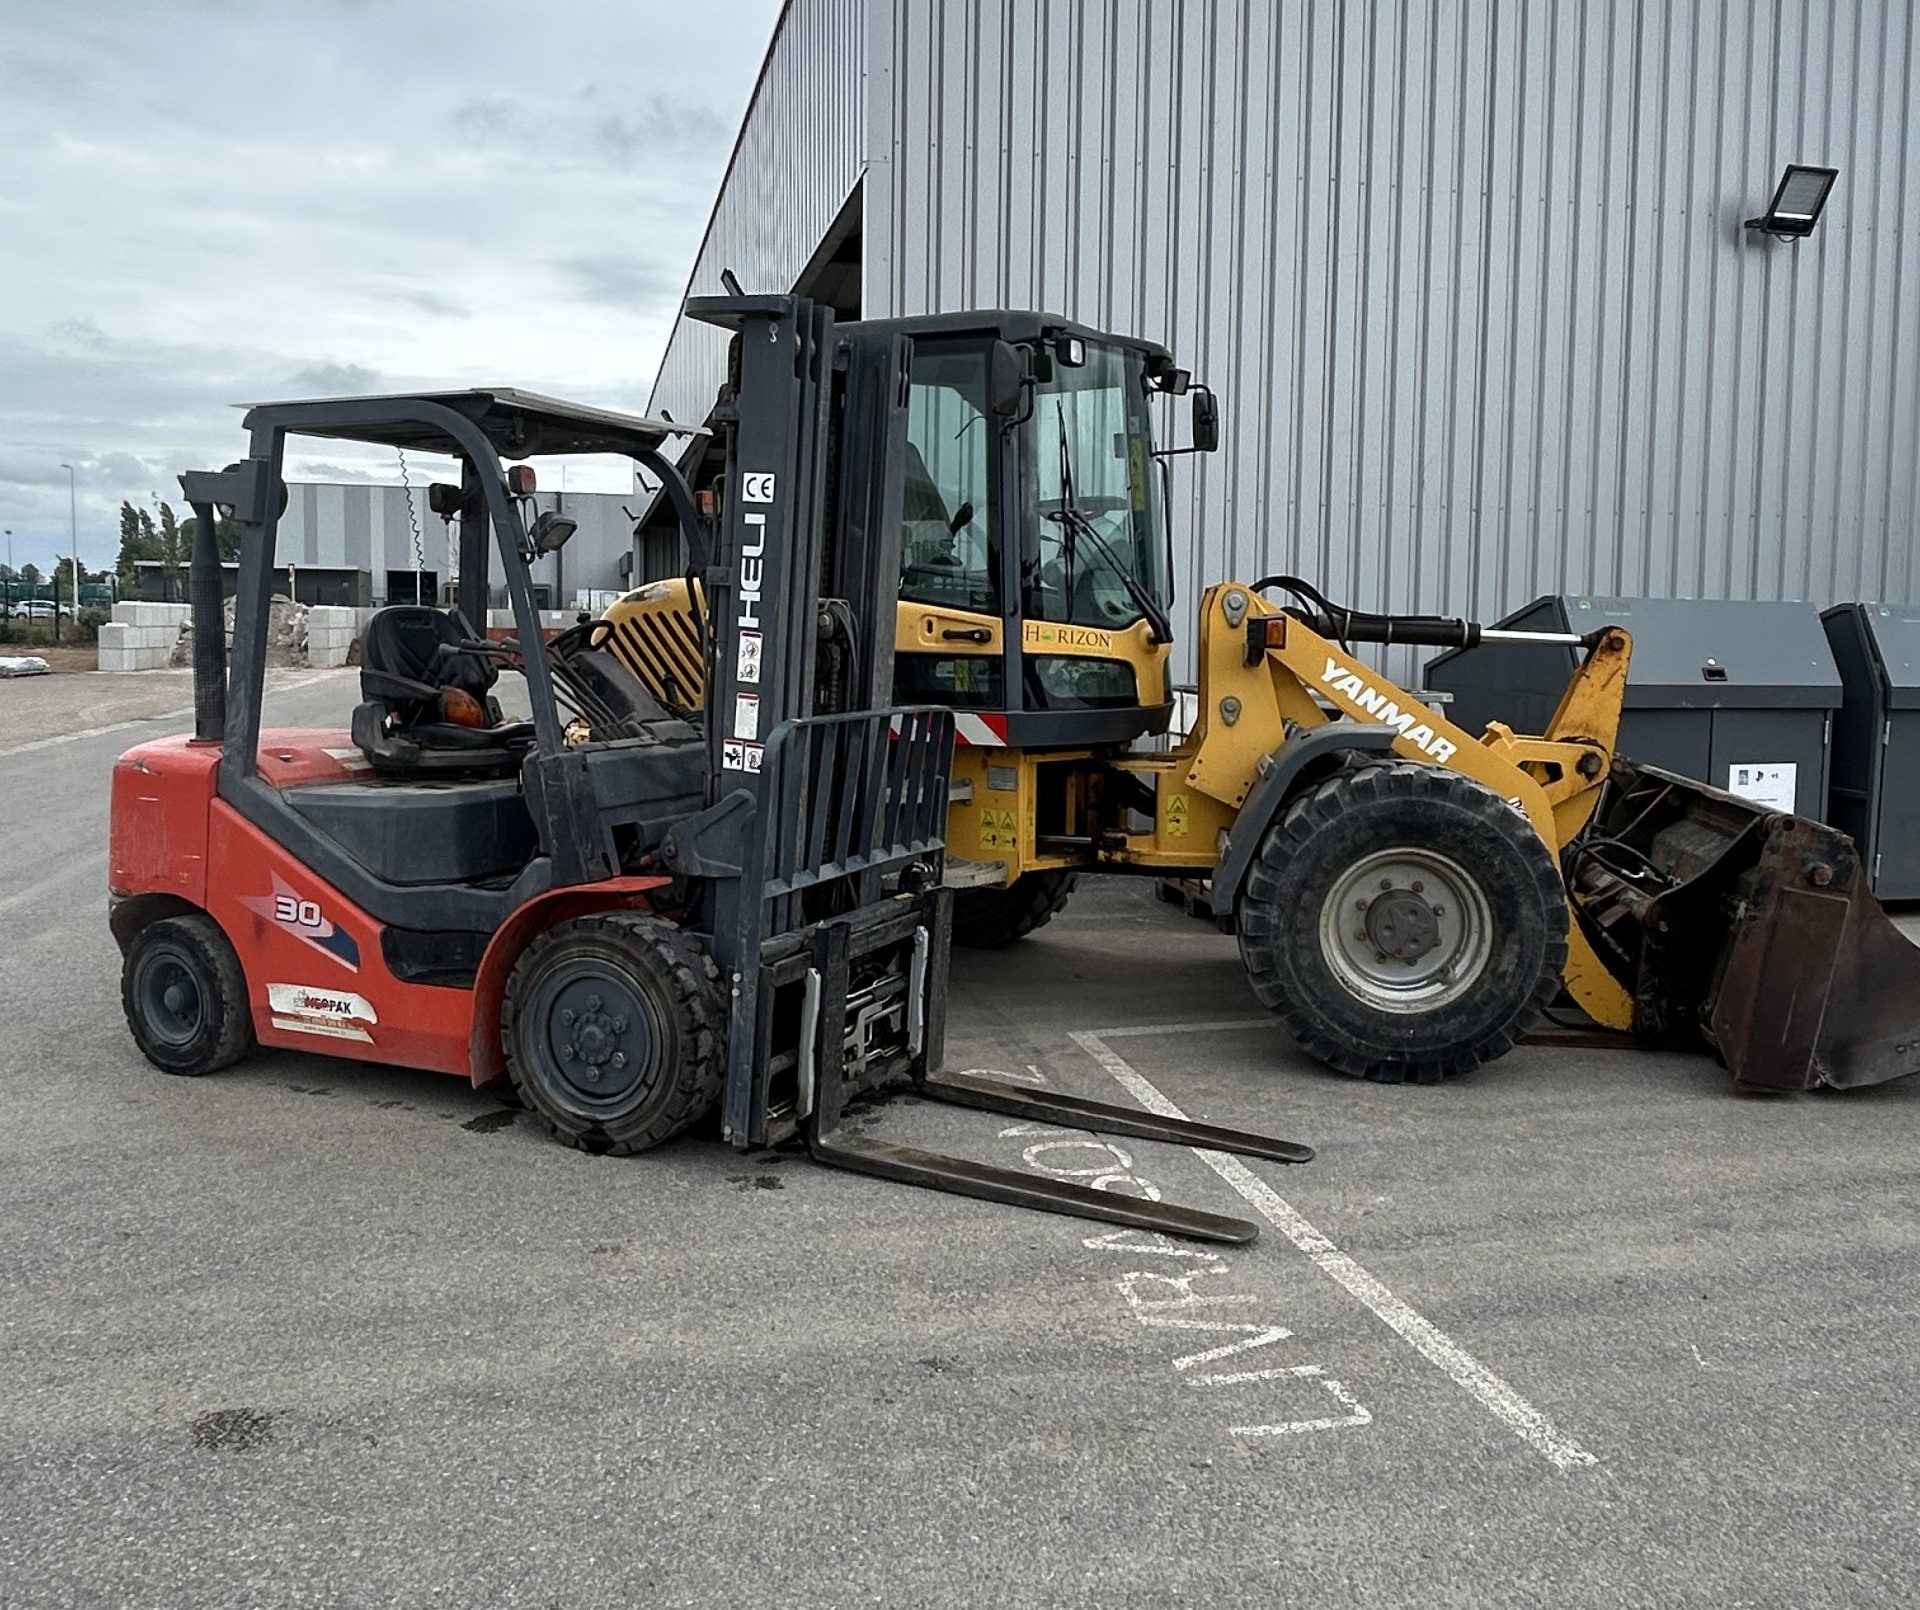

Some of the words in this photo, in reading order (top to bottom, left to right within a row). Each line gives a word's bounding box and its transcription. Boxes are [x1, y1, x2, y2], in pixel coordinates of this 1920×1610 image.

[746, 476, 772, 499] CE
[737, 513, 766, 629] HELI
[1025, 624, 1111, 648] HRIZON
[1320, 657, 1458, 764] YANMAR
[275, 895, 322, 927] 30
[998, 1121, 1373, 1437] LIVRASO
